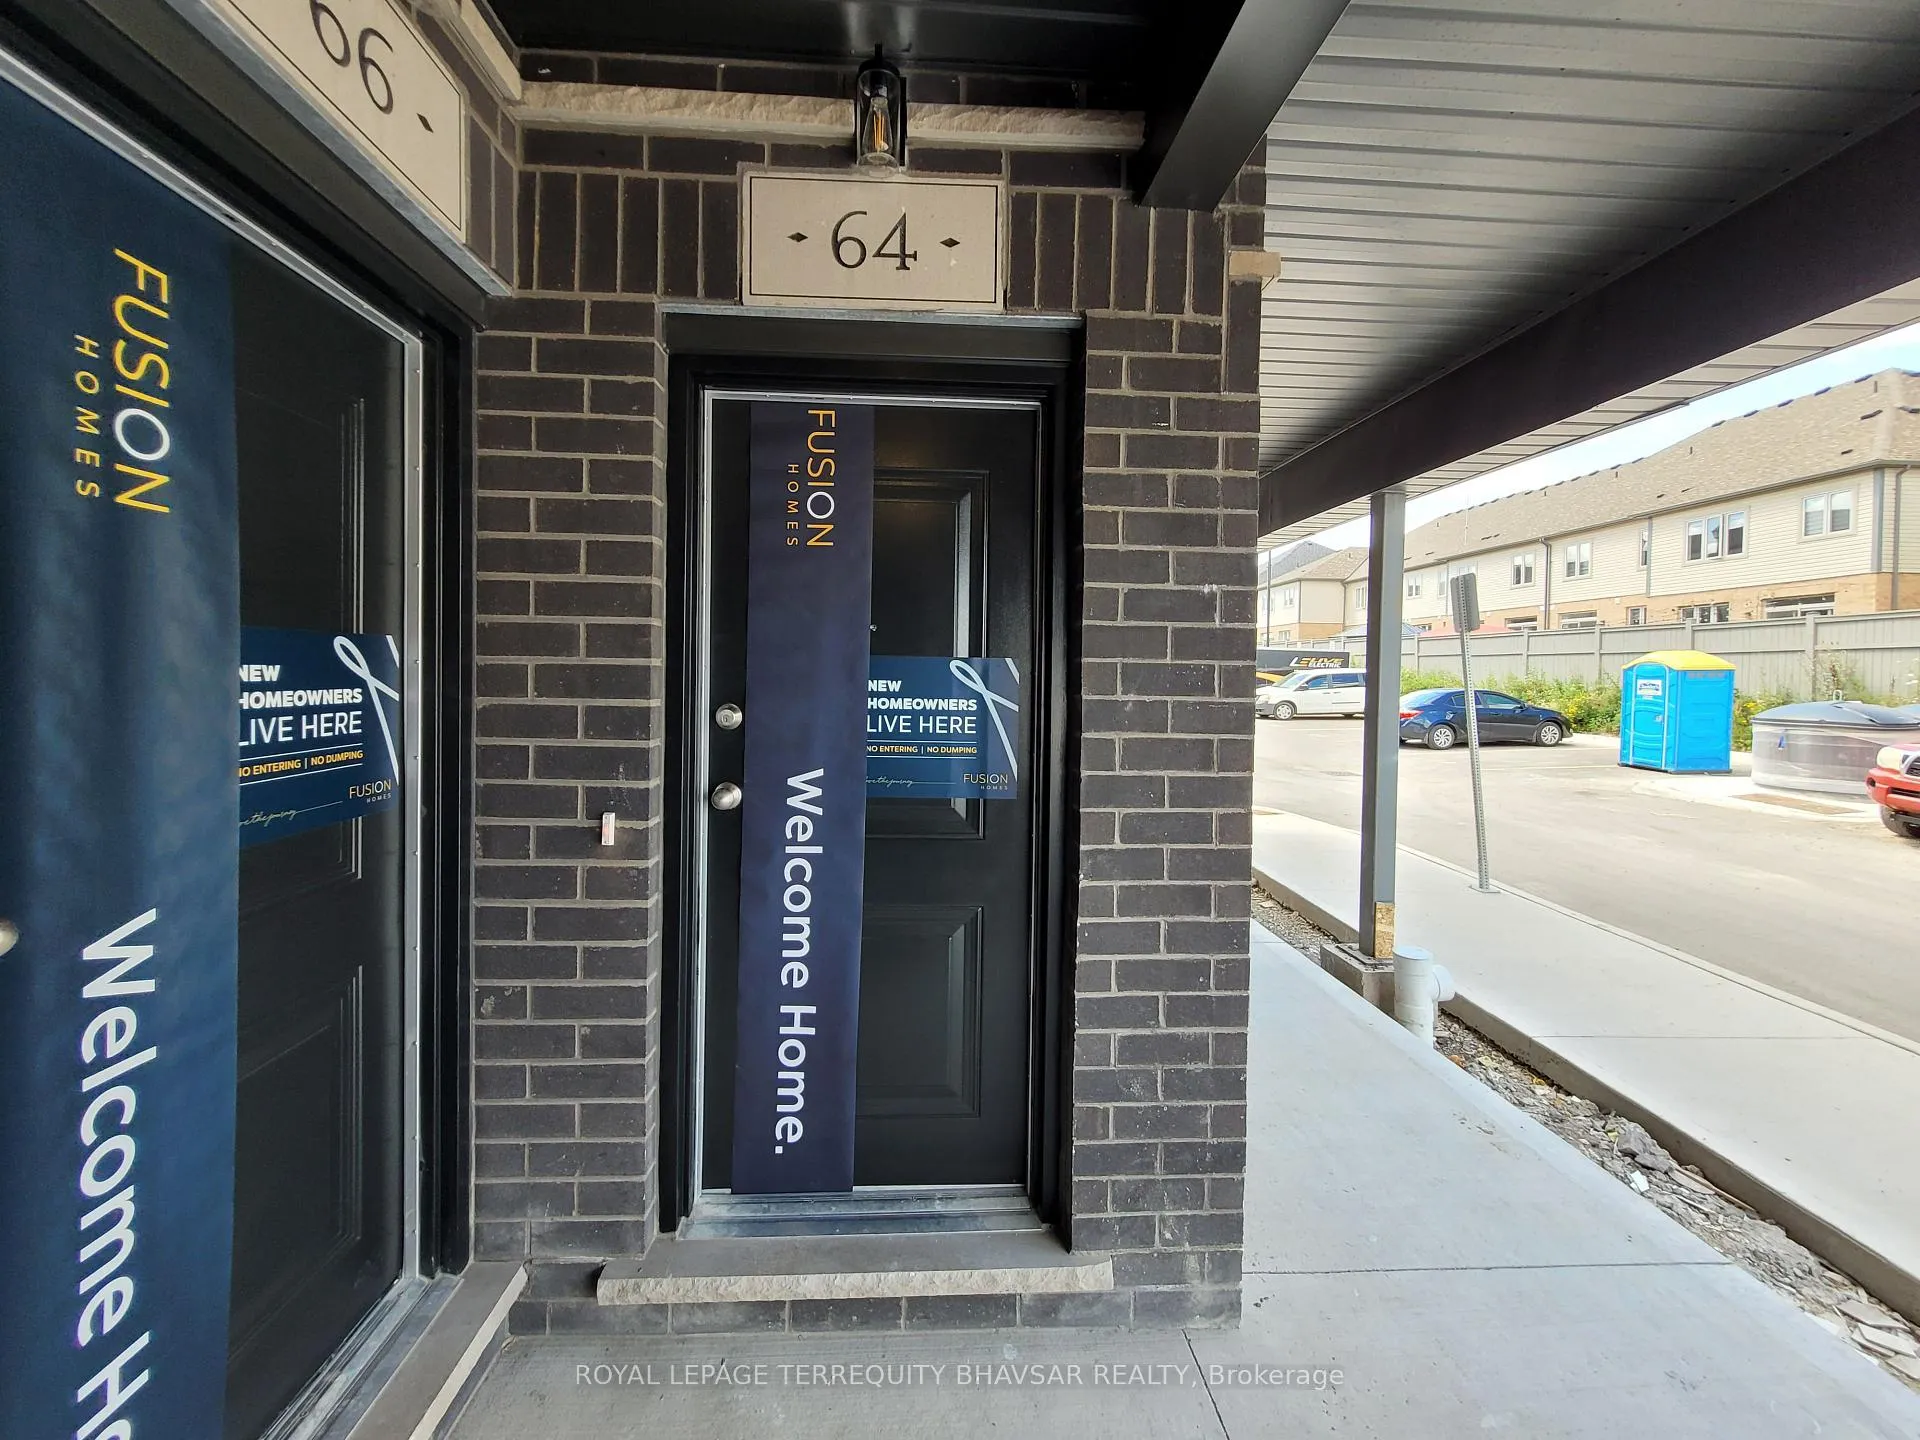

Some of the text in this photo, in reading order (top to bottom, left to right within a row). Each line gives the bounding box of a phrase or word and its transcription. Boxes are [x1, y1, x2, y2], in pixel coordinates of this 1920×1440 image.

[309, 0, 394, 115] 66
[831, 210, 918, 271] 64
[113, 248, 171, 513] FUSION
[74, 334, 101, 498] HOMES
[807, 409, 837, 547] FUSION
[786, 464, 800, 546] HOMES
[239, 664, 281, 682] NEW
[239, 688, 363, 710] HOMEOWNERS
[867, 680, 901, 693] NEW
[867, 697, 977, 711] HOMEOWNERS
[301, 710, 363, 740] HERE
[866, 715, 977, 734] LIVE HERE
[253, 759, 301, 775] ENTERING
[310, 755, 324, 766] NO
[326, 750, 363, 764] DUMPING
[879, 746, 918, 754] ENTERING
[940, 746, 977, 754] DUMPING
[349, 779, 392, 800] FUSION
[963, 773, 1008, 784] FUSION
[366, 792, 392, 804] HOMES
[774, 768, 825, 1155] Welcome Home.
[77, 908, 157, 1348] Welcome
